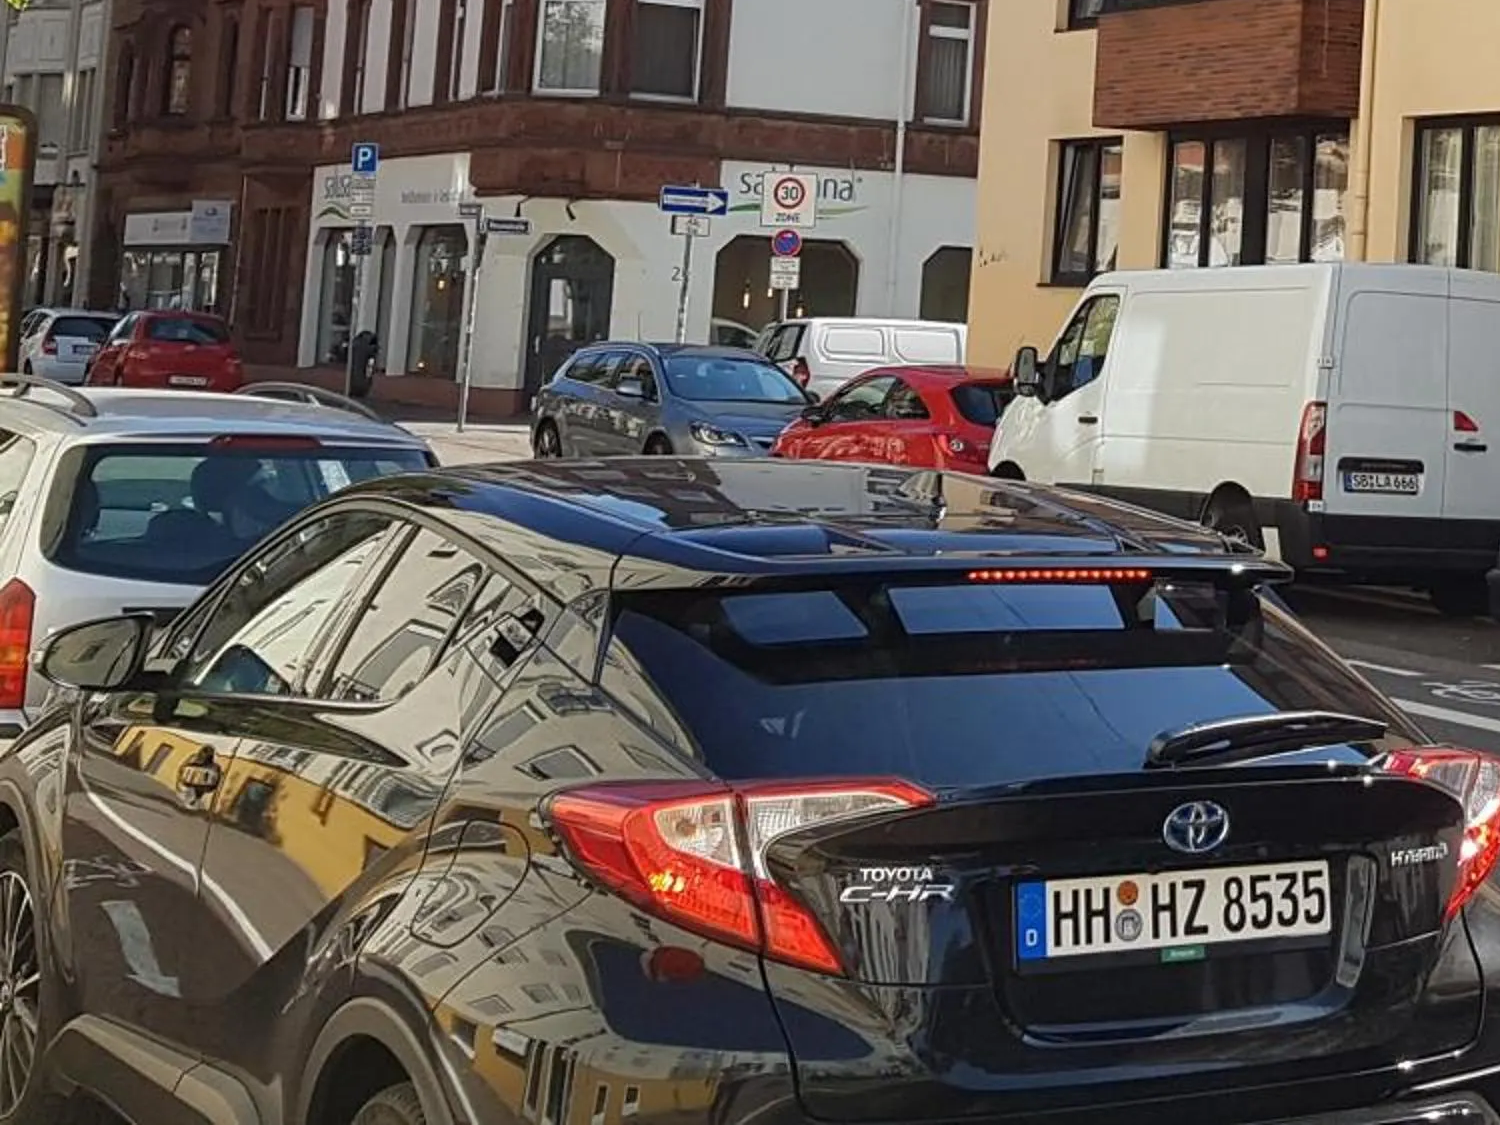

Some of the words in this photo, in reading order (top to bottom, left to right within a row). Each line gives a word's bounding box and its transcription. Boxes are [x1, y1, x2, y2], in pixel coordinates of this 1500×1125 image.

[357, 147, 371, 169] P
[780, 186, 799, 201] 30
[775, 212, 801, 223] ZONE
[1353, 474, 1369, 488] SB
[1376, 475, 1393, 488] LA
[860, 867, 934, 882] TOYOTA
[839, 884, 955, 903] C-HR
[1053, 887, 1111, 947] HH
[1152, 879, 1208, 939] HZ
[1222, 870, 1326, 933] 8535
